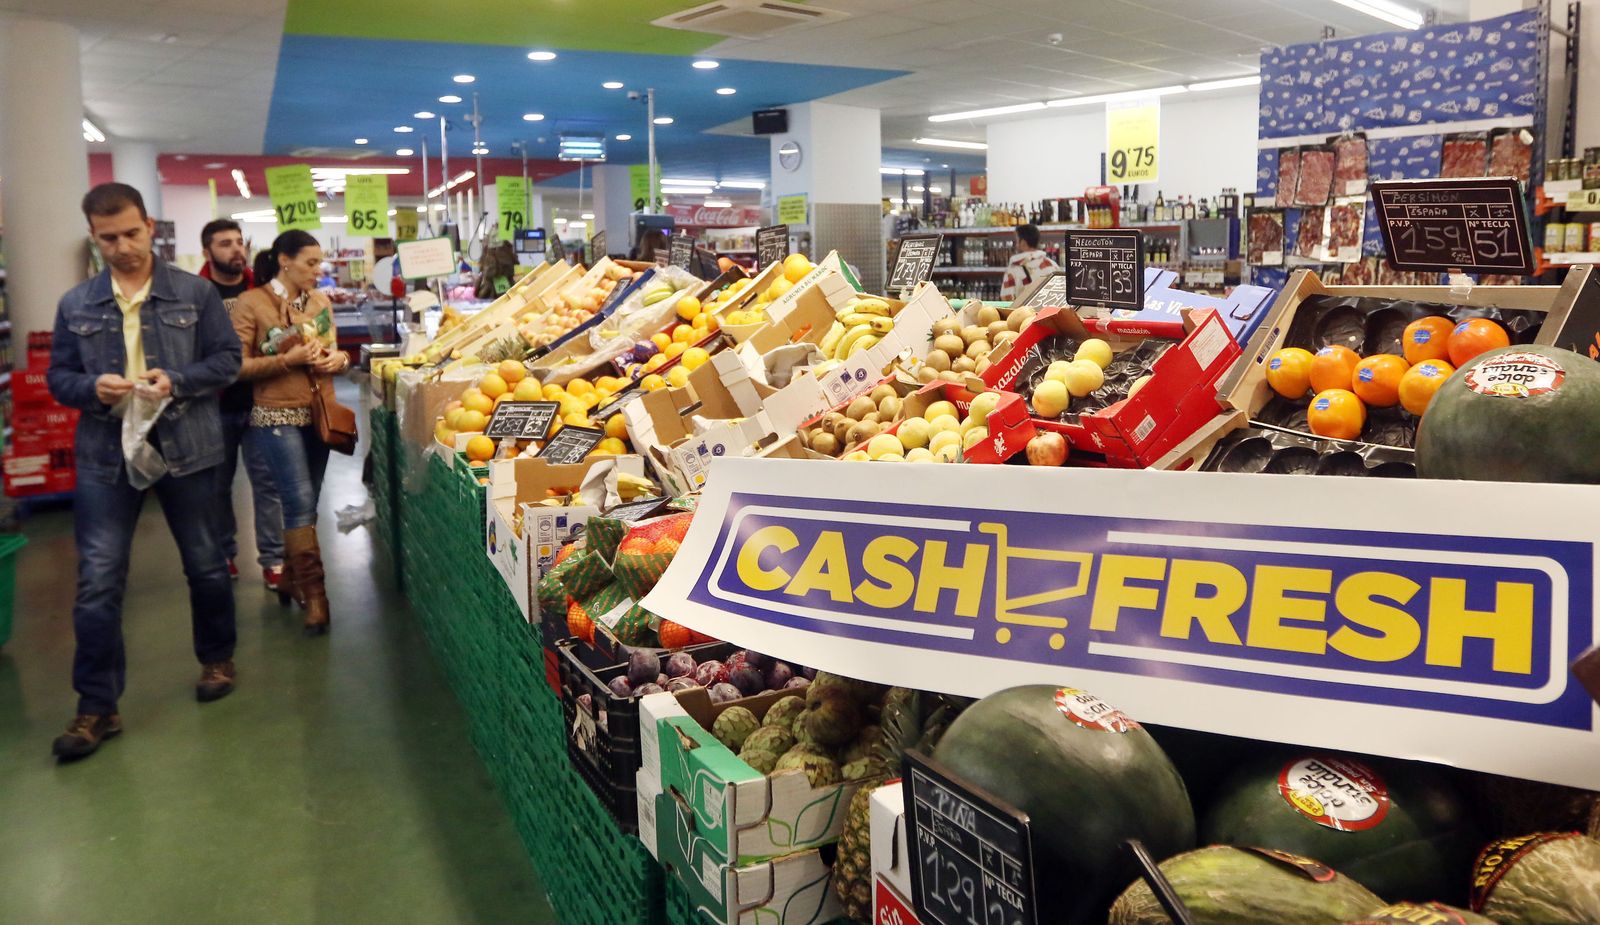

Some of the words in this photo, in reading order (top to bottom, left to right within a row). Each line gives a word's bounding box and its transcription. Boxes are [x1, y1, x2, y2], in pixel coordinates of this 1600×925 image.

[1411, 207, 1448, 216] ESPAÑA
[1481, 220, 1511, 228] TECLA
[1474, 228, 1519, 258] 51
[1112, 269, 1133, 294] 33
[738, 526, 990, 618] CASH
[1092, 554, 1534, 675] FRESH
[933, 788, 976, 833] PIÑA
[919, 828, 938, 850] P.V.P.
[996, 882, 1024, 912] TECLA
